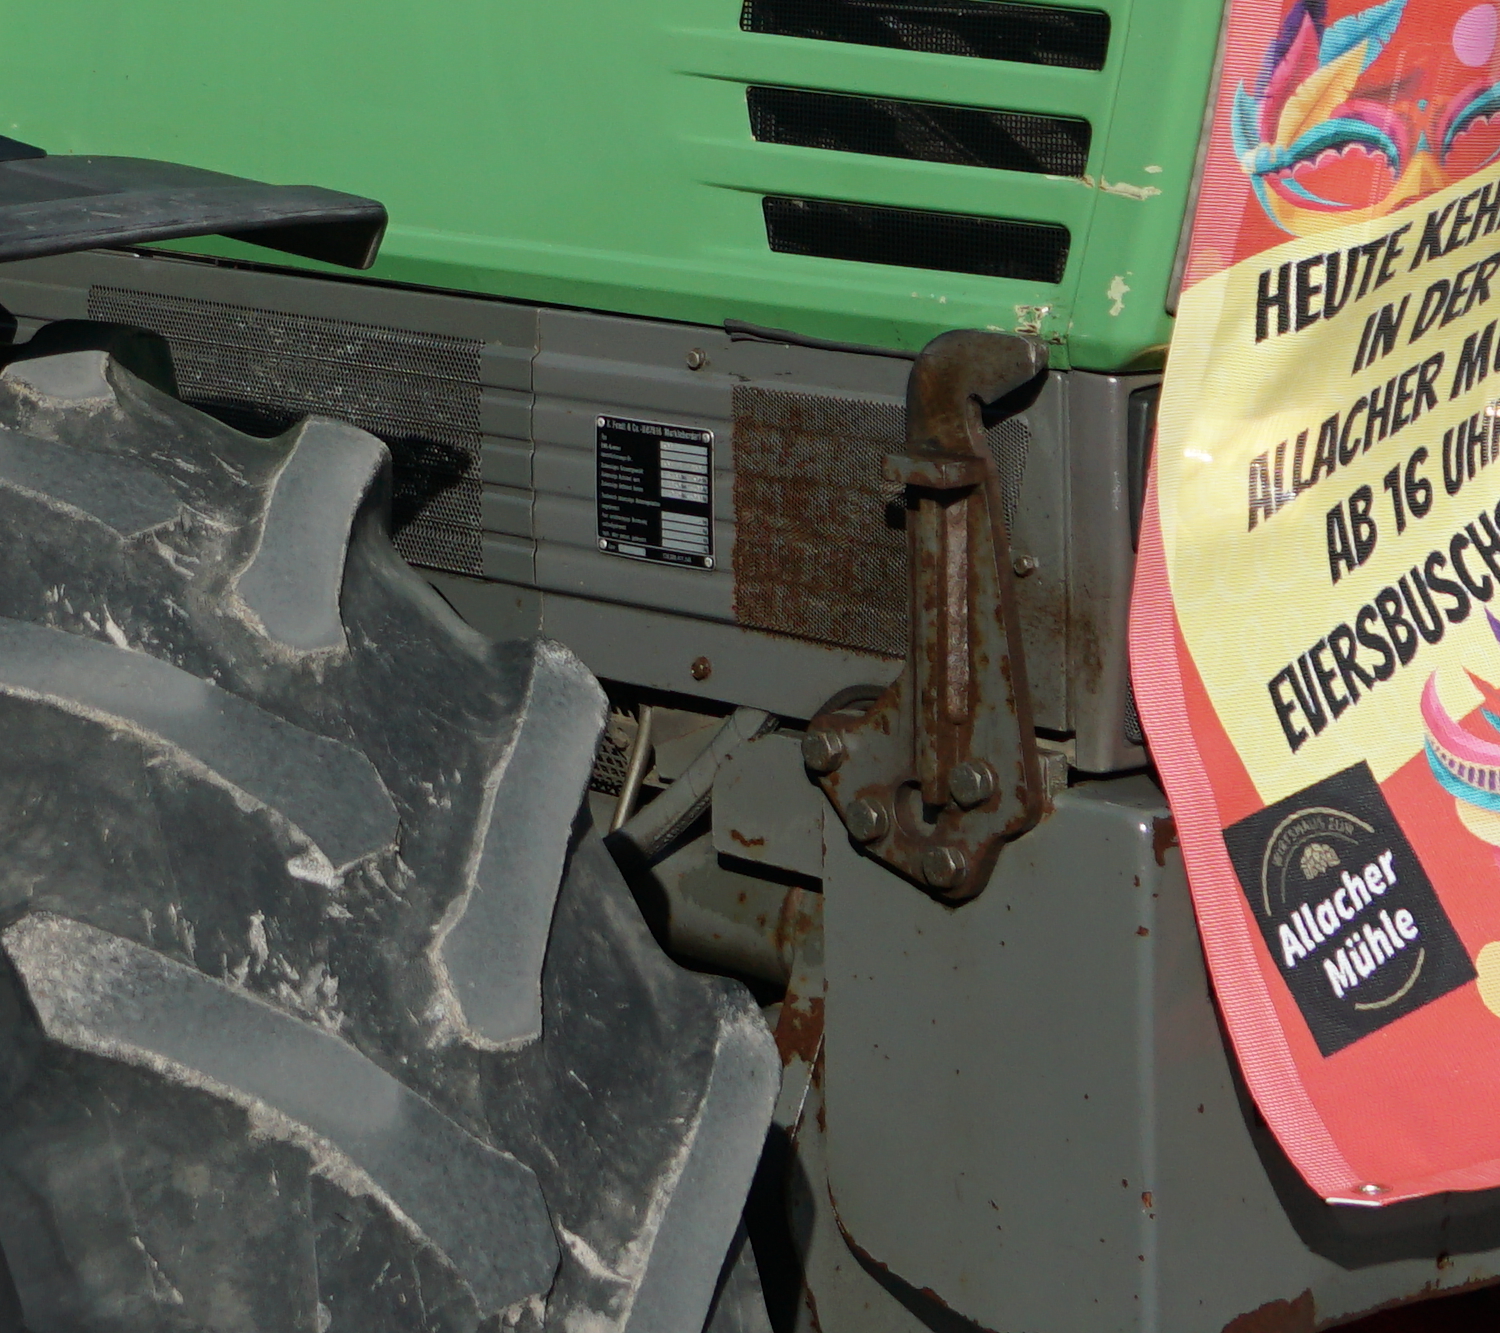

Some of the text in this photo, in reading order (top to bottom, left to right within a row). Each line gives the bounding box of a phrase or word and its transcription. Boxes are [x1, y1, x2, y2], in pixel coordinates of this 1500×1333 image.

[1254, 221, 1411, 343] HEUTE
[1351, 296, 1408, 376] IN
[1247, 354, 1442, 533] ALLACHER
[1325, 484, 1378, 586] AB
[1383, 446, 1433, 537] 16
[1277, 848, 1398, 968] Allacher
[1323, 907, 1419, 1000] Mühle
